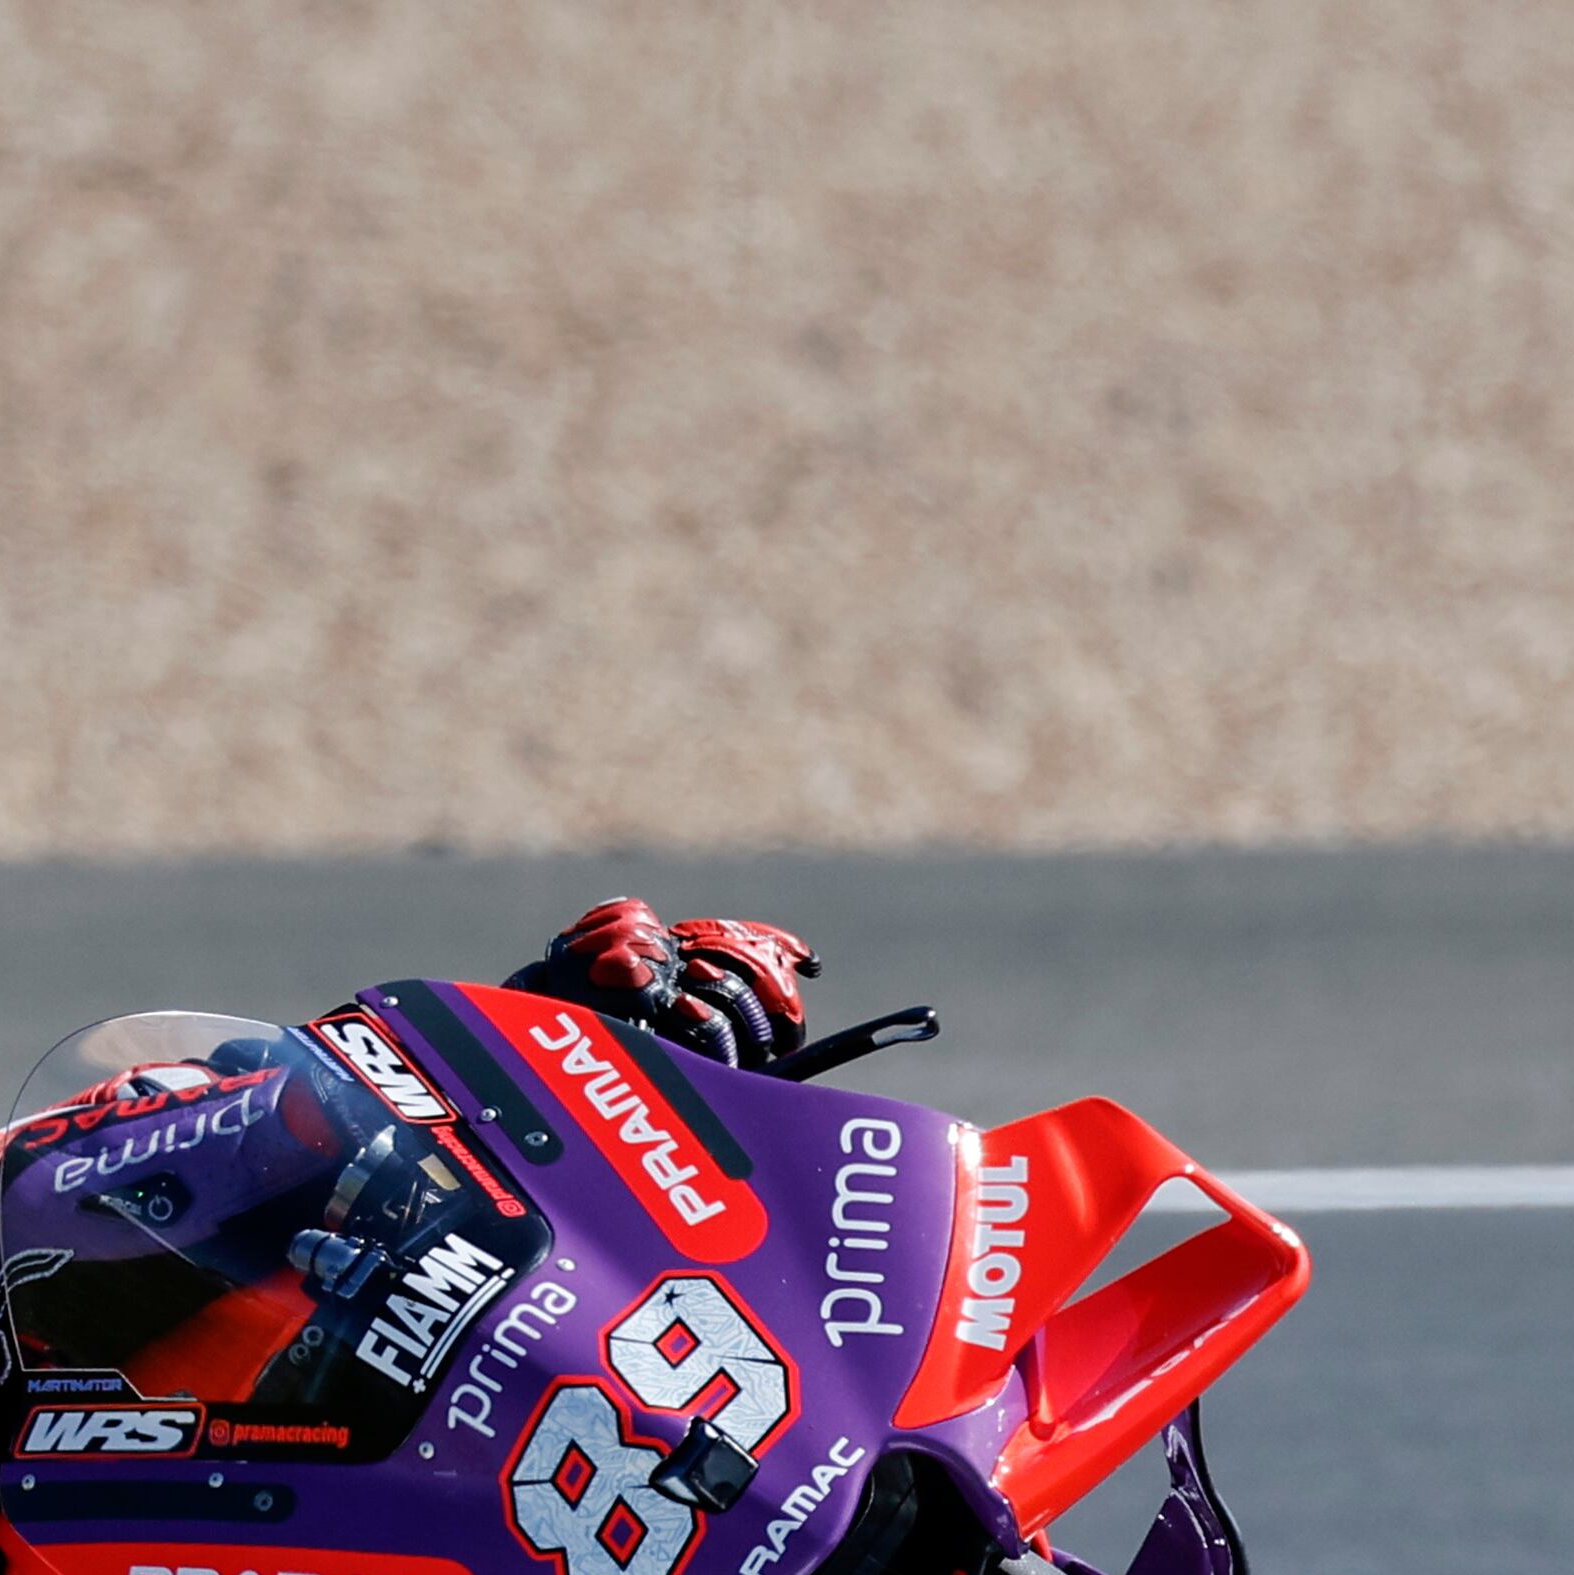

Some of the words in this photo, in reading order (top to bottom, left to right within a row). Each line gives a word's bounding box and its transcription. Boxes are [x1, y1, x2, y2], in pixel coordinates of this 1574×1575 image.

[320, 1022, 446, 1117] WRS
[529, 1012, 726, 1227] PRAMAC
[54, 1087, 263, 1192] prima
[820, 1117, 906, 1348] prima
[955, 1155, 1029, 1351] MOTUL
[355, 1233, 505, 1386] FIAMM
[447, 1280, 578, 1437] prima
[25, 1410, 195, 1450] WRS
[27, 1379, 123, 1392] MARTINATOR
[232, 1422, 349, 1448] pramacracing
